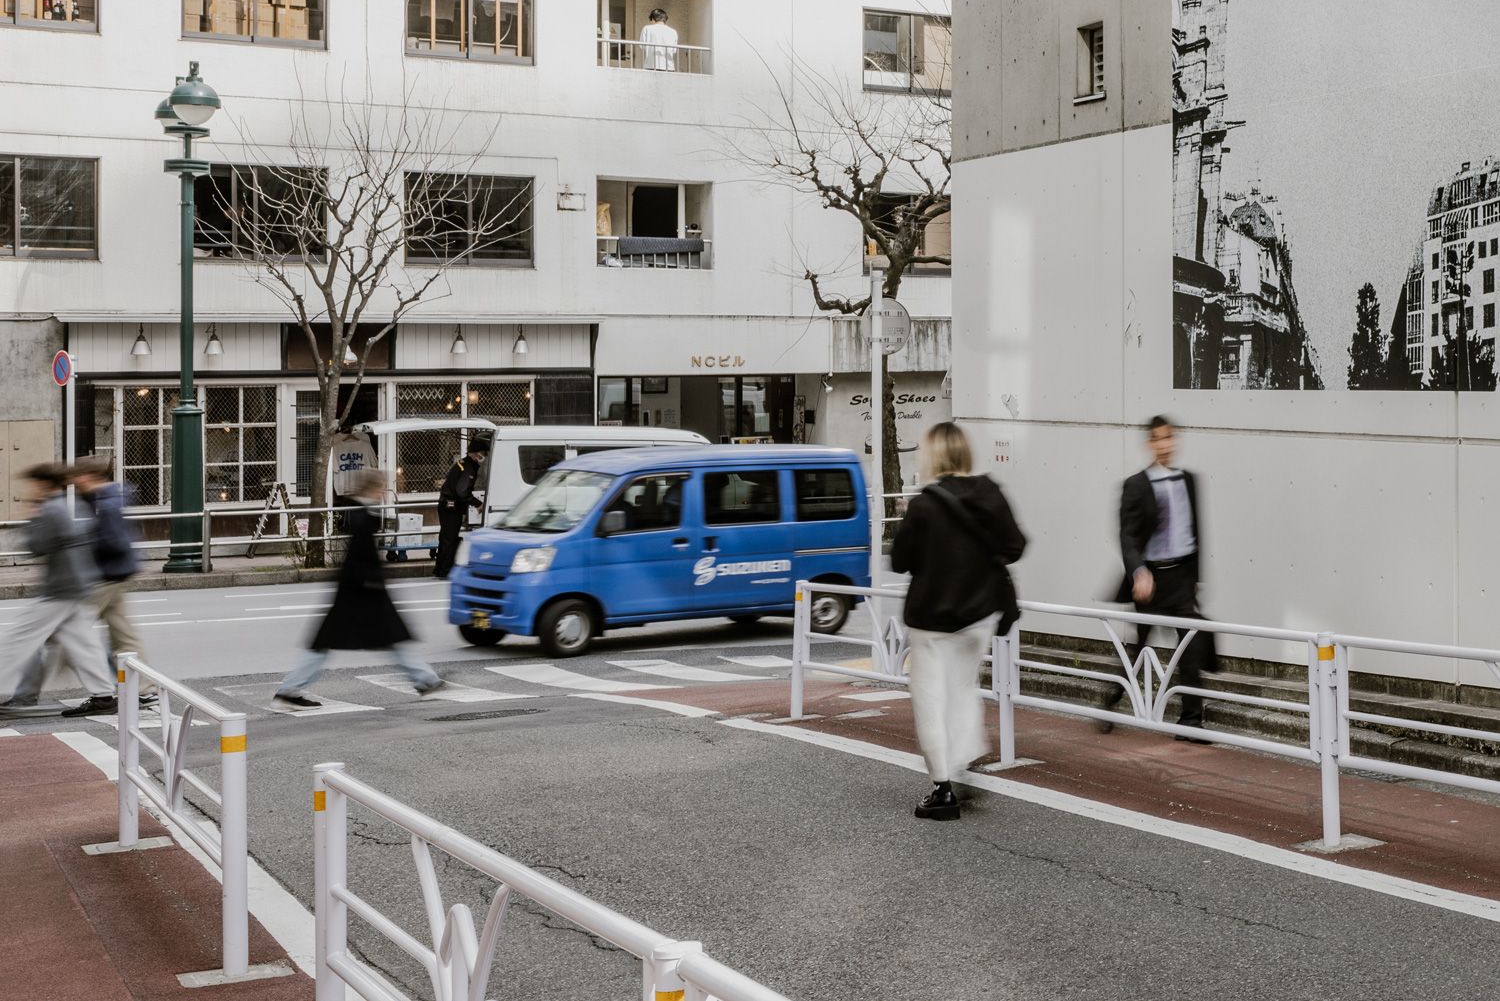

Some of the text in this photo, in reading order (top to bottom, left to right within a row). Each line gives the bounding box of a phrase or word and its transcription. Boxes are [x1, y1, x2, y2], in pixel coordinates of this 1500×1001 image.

[691, 355, 746, 368] NCビル
[895, 393, 936, 404] Shoes
[340, 452, 363, 461] CASH
[339, 463, 365, 471] CREDIT
